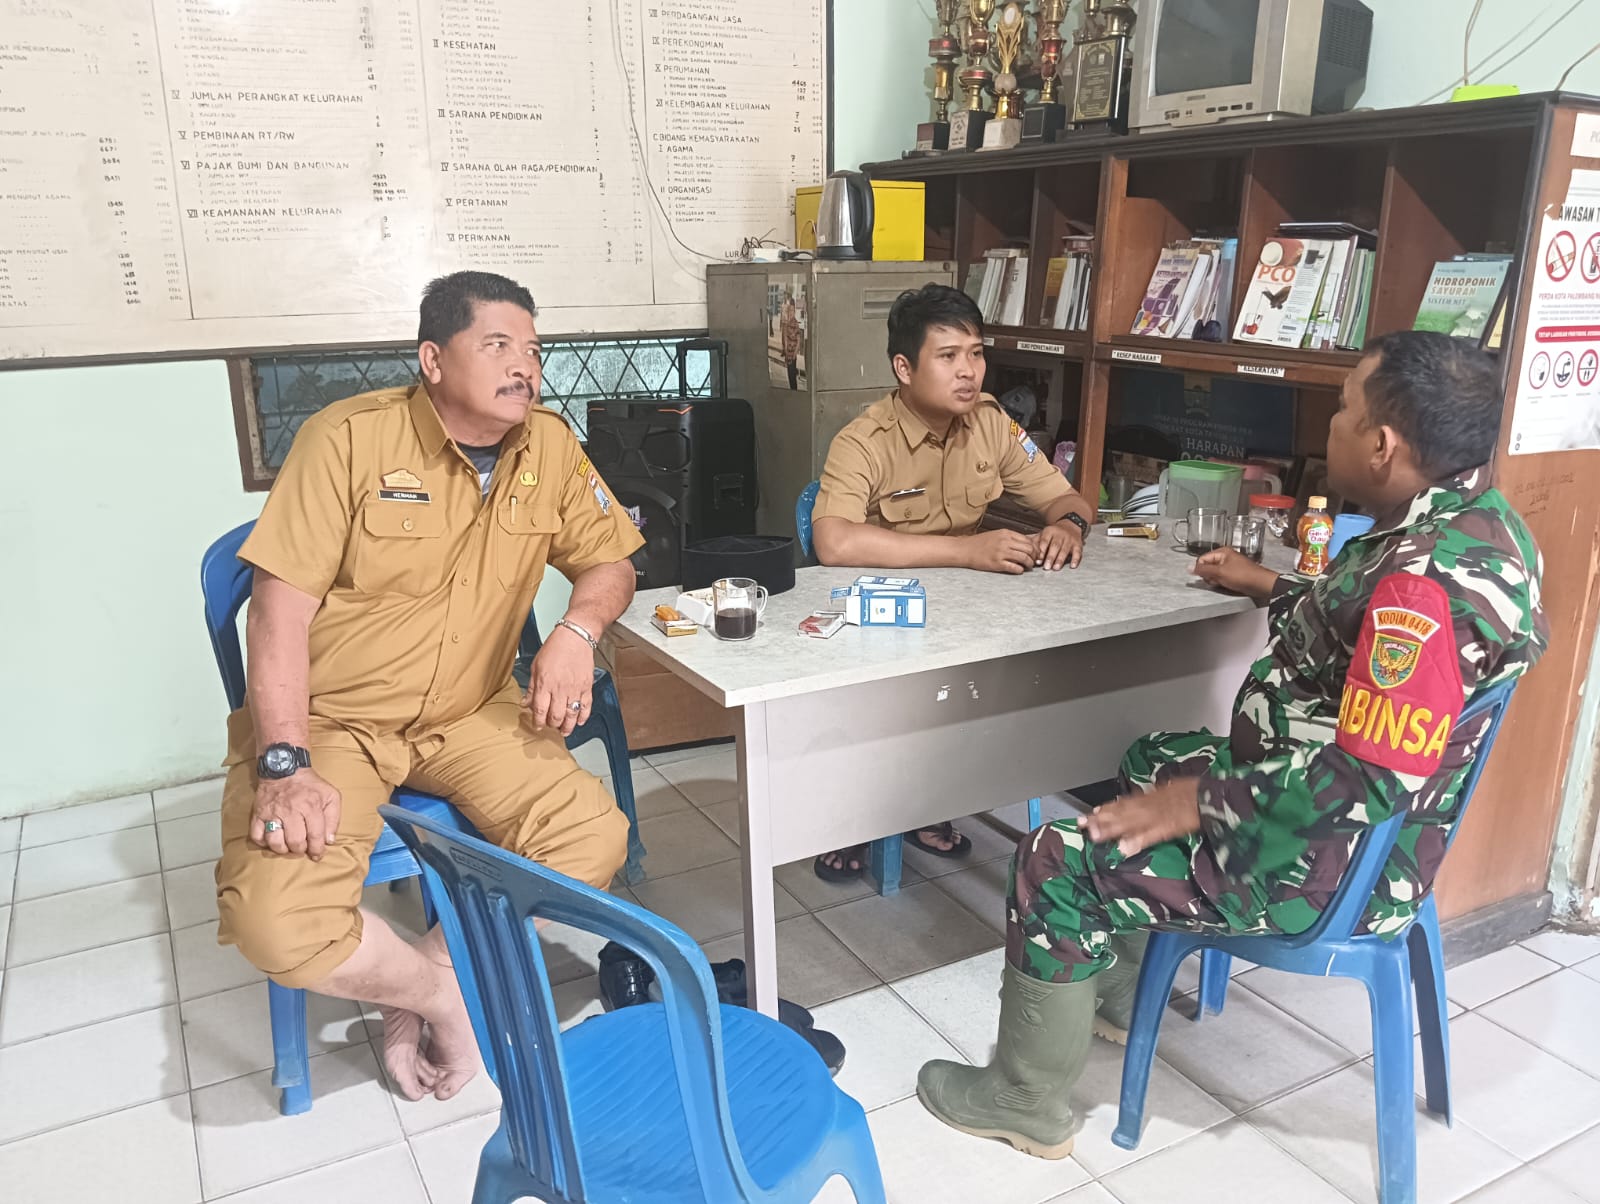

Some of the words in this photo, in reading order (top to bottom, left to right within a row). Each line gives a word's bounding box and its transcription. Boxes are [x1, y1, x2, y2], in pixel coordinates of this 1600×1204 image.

[661, 9, 720, 23] PERDAGANGAN
[722, 14, 743, 24] JASA
[443, 40, 497, 51] KESEHATAN
[662, 37, 725, 49] PEREKONOMIAN
[663, 64, 711, 75] PERUMAHAN
[190, 91, 233, 101] JUMLAH
[237, 91, 300, 102] PERANGKAT
[302, 93, 364, 103] KELURAHAN
[664, 99, 722, 110] KELEMBAGAAN
[725, 102, 772, 111] KELURAHAN
[449, 109, 488, 119] SARANA
[489, 111, 543, 122] PENDIDIKAN
[193, 131, 255, 141] PEMBINAAN
[258, 131, 296, 141] RT/RW
[689, 135, 761, 144] KEMASYARAKATAN
[666, 145, 694, 153] AGAMA
[196, 160, 233, 171] PAJAK
[237, 160, 262, 170] BUMI
[267, 161, 289, 170] DAN
[453, 162, 491, 172] SARANA
[494, 162, 518, 172] OLAH
[521, 163, 599, 174] RAGA/PENDIDIKAN
[668, 186, 713, 195] ORGANISASI
[456, 199, 509, 207] PERTANIAN
[202, 208, 276, 218] KEAMANANAN
[282, 207, 344, 218] KELURAHAN
[458, 233, 511, 242] PERIKANAN
[724, 249, 744, 258] LUR
[1257, 265, 1297, 283] PCO
[1433, 276, 1497, 288] HIDROPONIK
[1430, 286, 1477, 297] SAYURAN
[1186, 436, 1246, 459] HARAPAN
[1376, 610, 1408, 627] KODIM
[1407, 614, 1433, 637] 0418
